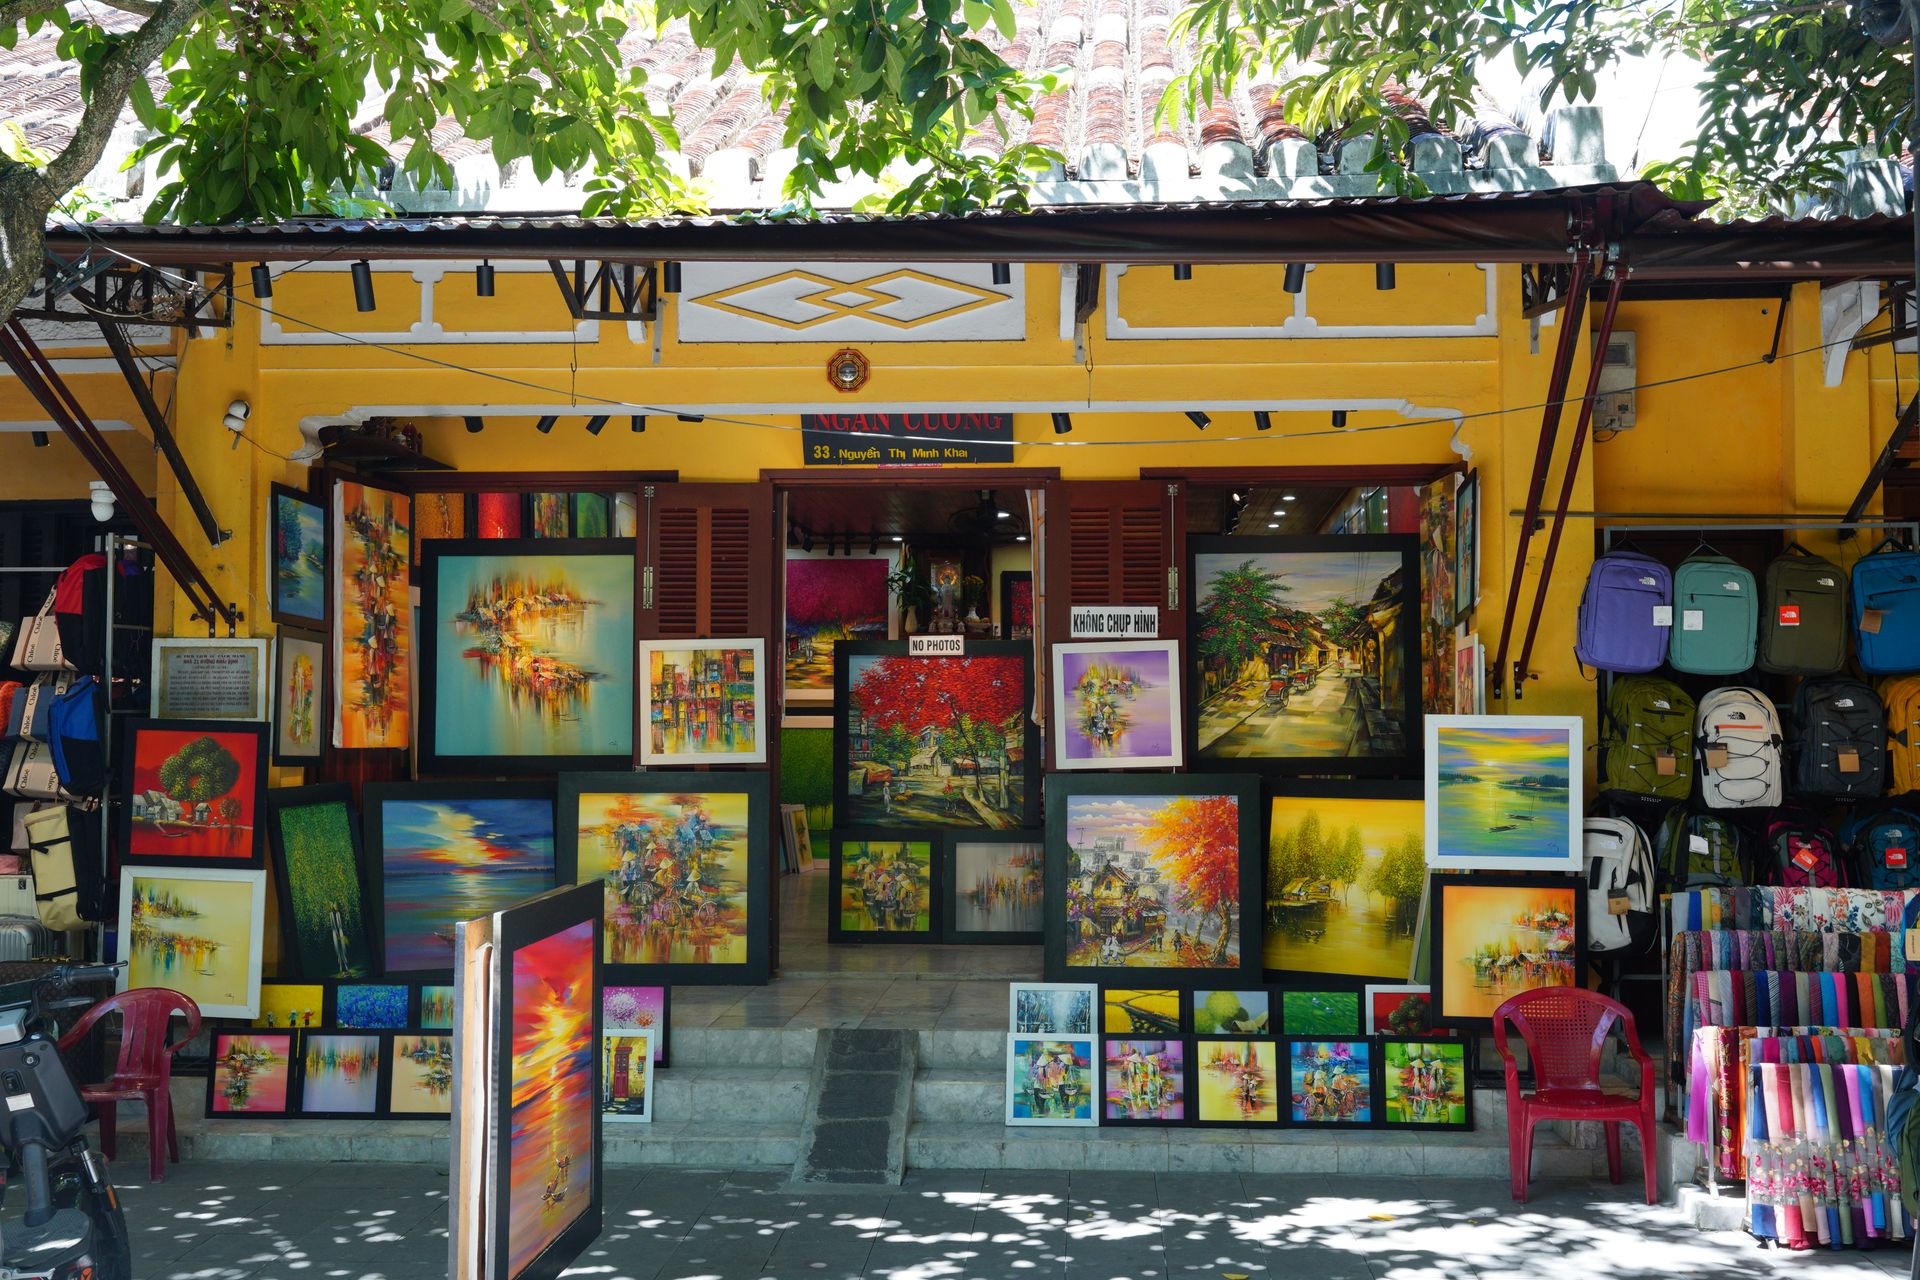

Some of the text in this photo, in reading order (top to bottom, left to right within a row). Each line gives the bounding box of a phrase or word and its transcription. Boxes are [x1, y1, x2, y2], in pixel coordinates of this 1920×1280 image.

[1073, 609, 1156, 637] KHÔNG CHỤP HÌNH
[912, 639, 961, 652] NO PHOTOS
